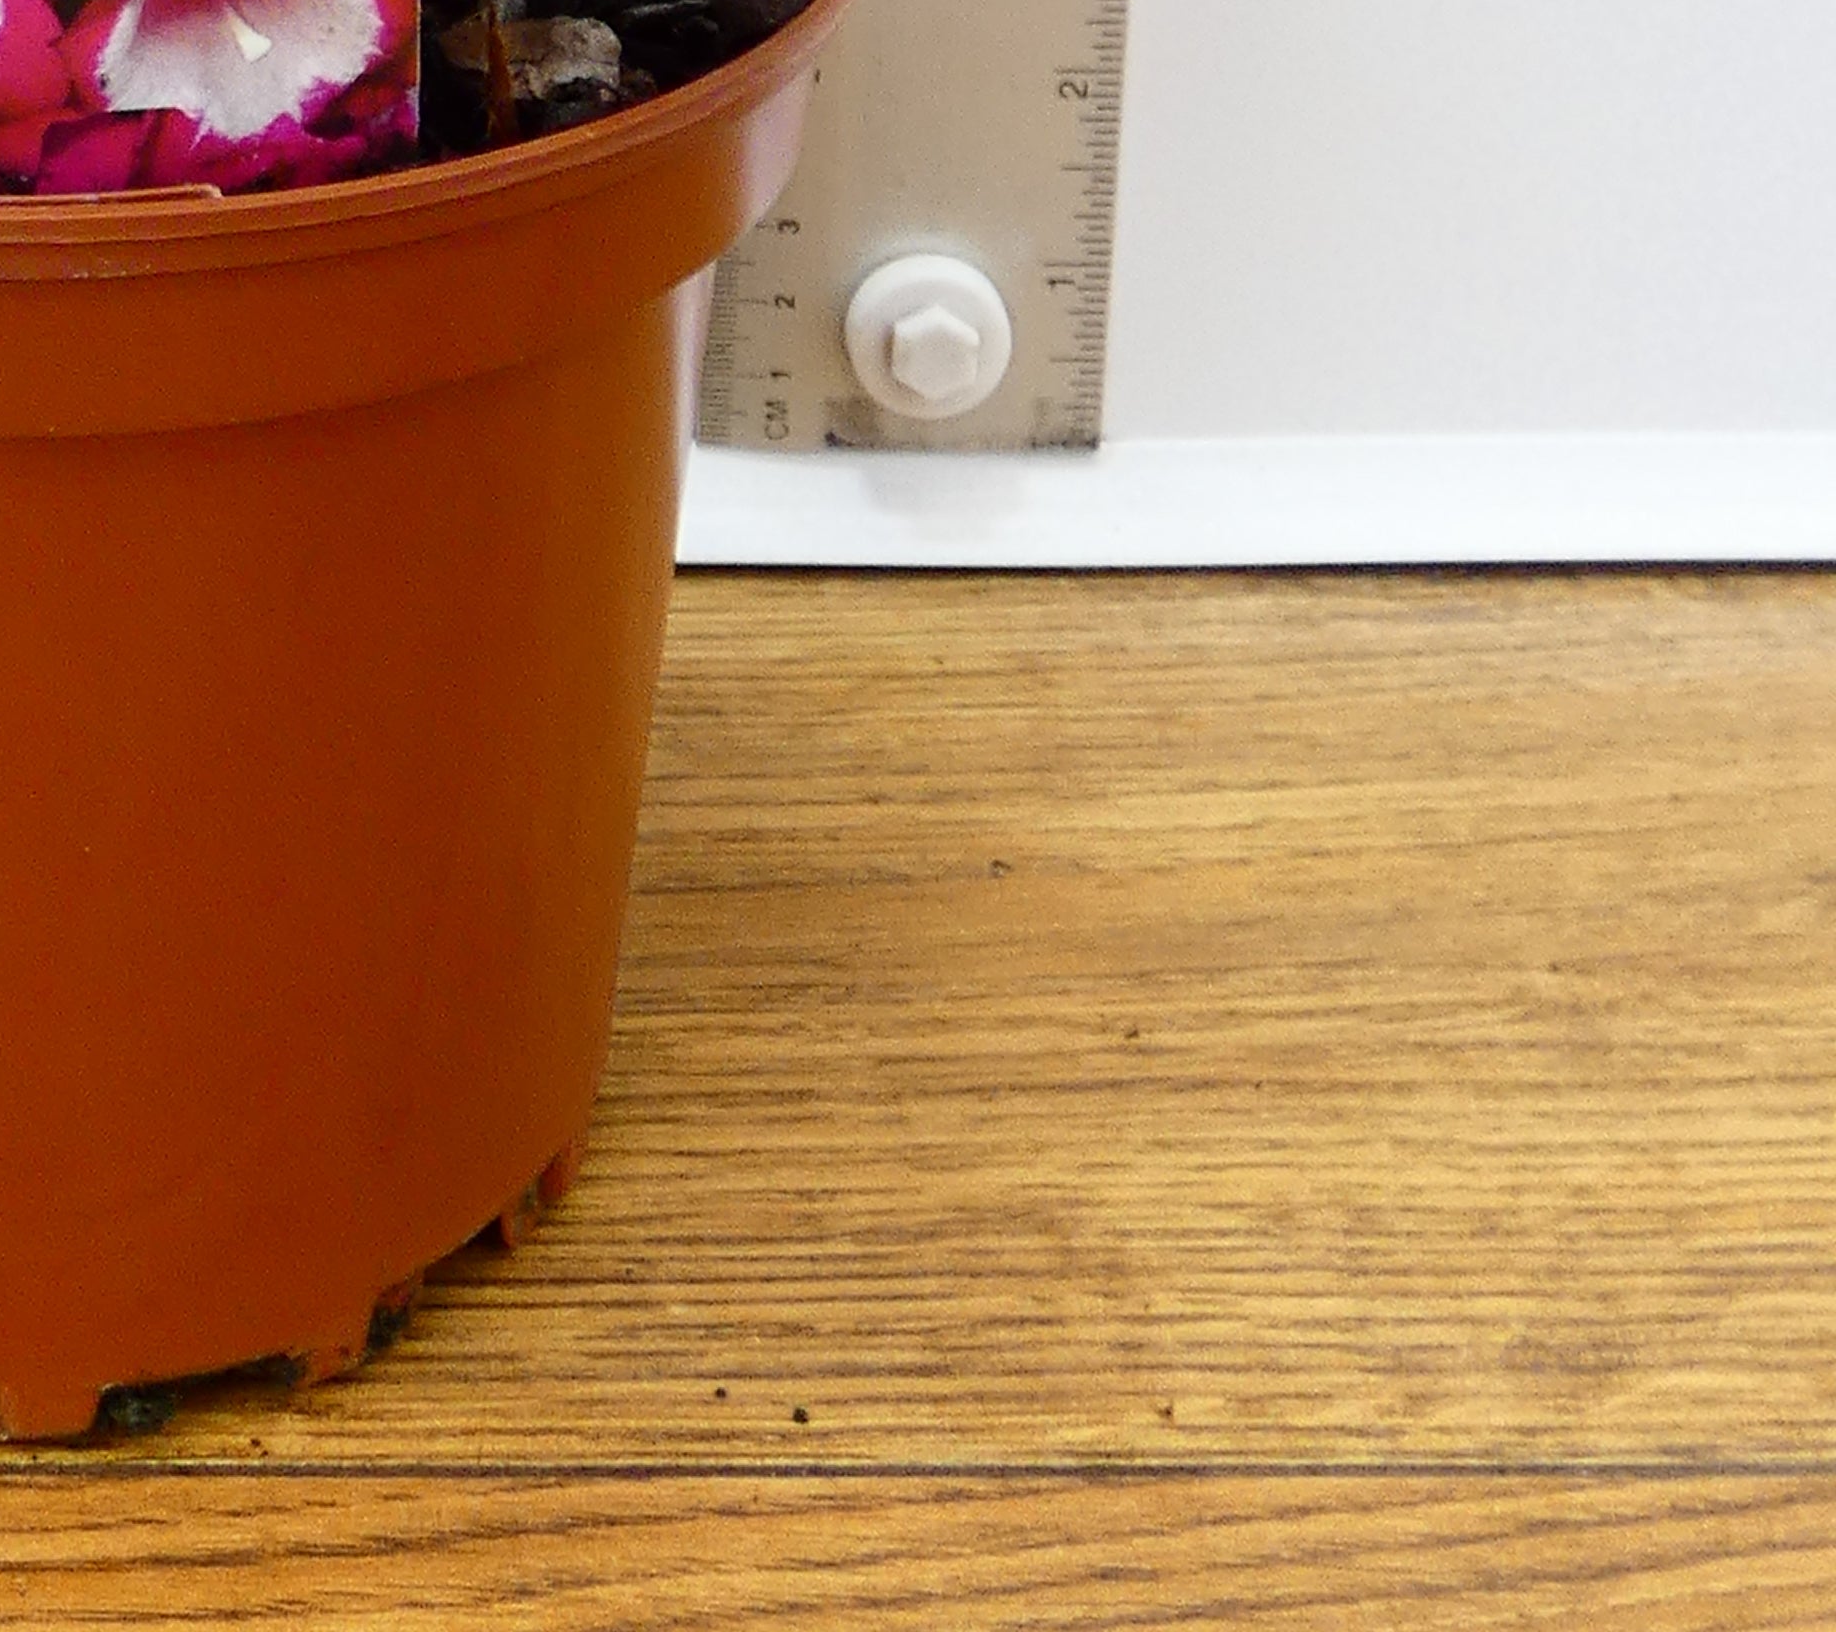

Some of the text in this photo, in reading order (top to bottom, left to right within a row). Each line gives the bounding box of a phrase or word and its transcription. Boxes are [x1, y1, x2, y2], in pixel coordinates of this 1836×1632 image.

[1059, 80, 1089, 98] 2
[777, 218, 800, 234] 3
[774, 293, 796, 308] 2
[765, 400, 788, 440] CM
